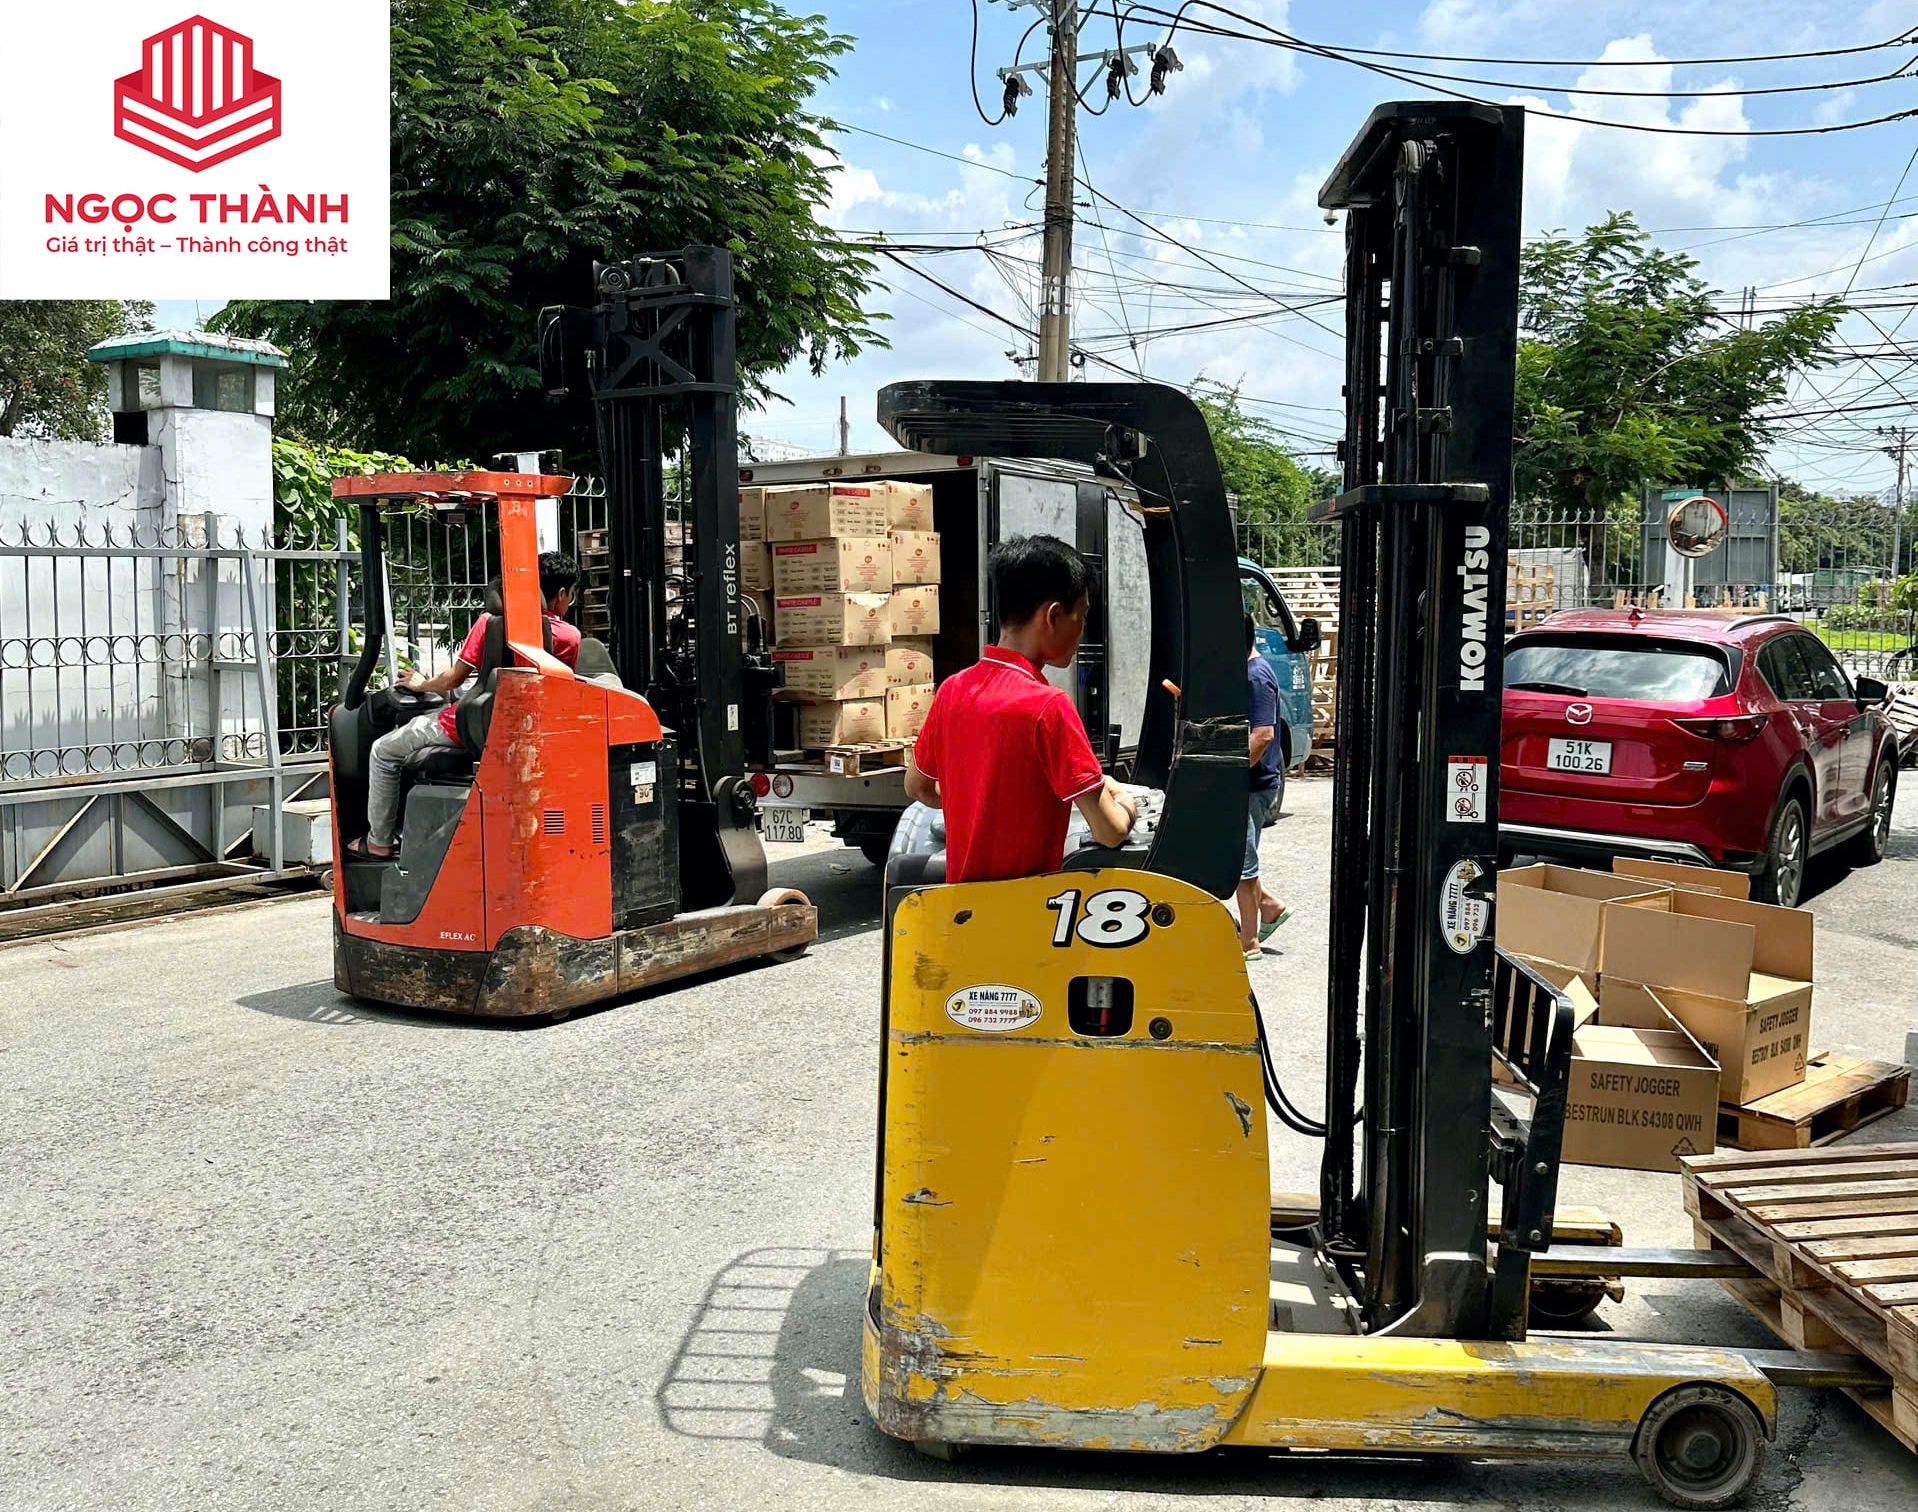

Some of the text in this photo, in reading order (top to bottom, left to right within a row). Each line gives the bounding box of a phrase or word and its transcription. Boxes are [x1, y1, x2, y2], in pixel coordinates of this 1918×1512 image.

[723, 543, 737, 635] BT reflex
[1457, 525, 1490, 691] KOMATSU
[1566, 741, 1593, 755] 51K
[1555, 754, 1603, 771] 100.26
[772, 809, 793, 824] 67C
[766, 824, 802, 840] 117.80
[1046, 889, 1152, 948] 18
[1447, 921, 1456, 930] XE
[464, 933, 476, 941] AC
[969, 991, 977, 1001] XE
[1001, 992, 1018, 1001] 7777
[1590, 1072, 1680, 1097] SAFETY JOGGER
[1566, 1103, 1616, 1124] BESTRUN
[1617, 1109, 1640, 1126] BLK
[1676, 1114, 1702, 1132] QWH
